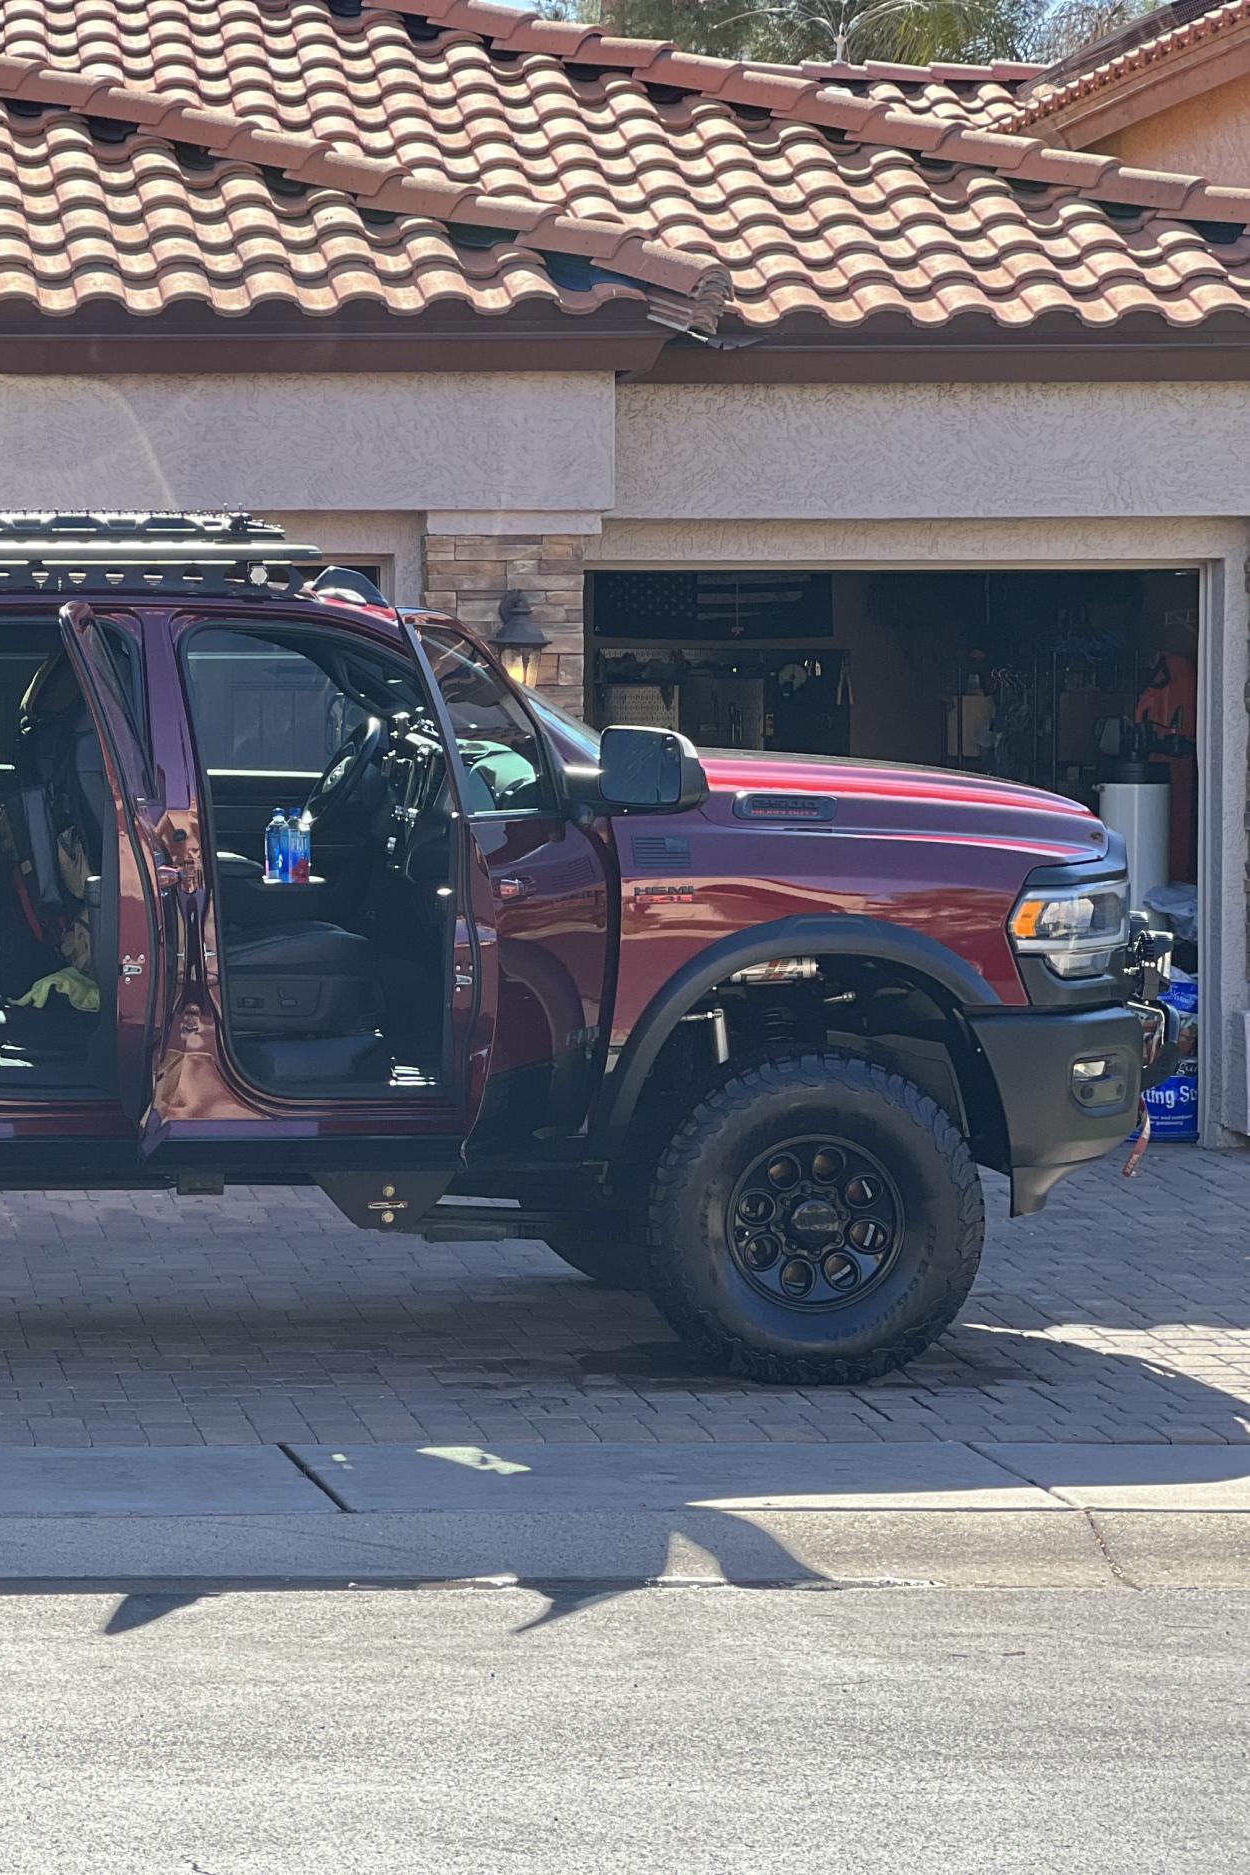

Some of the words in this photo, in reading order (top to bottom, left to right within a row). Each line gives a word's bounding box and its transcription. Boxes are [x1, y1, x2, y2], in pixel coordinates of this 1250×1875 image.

[634, 886, 694, 896] HEMI
[1146, 1089, 1175, 1109] ting
[1180, 1085, 1199, 1102] So
